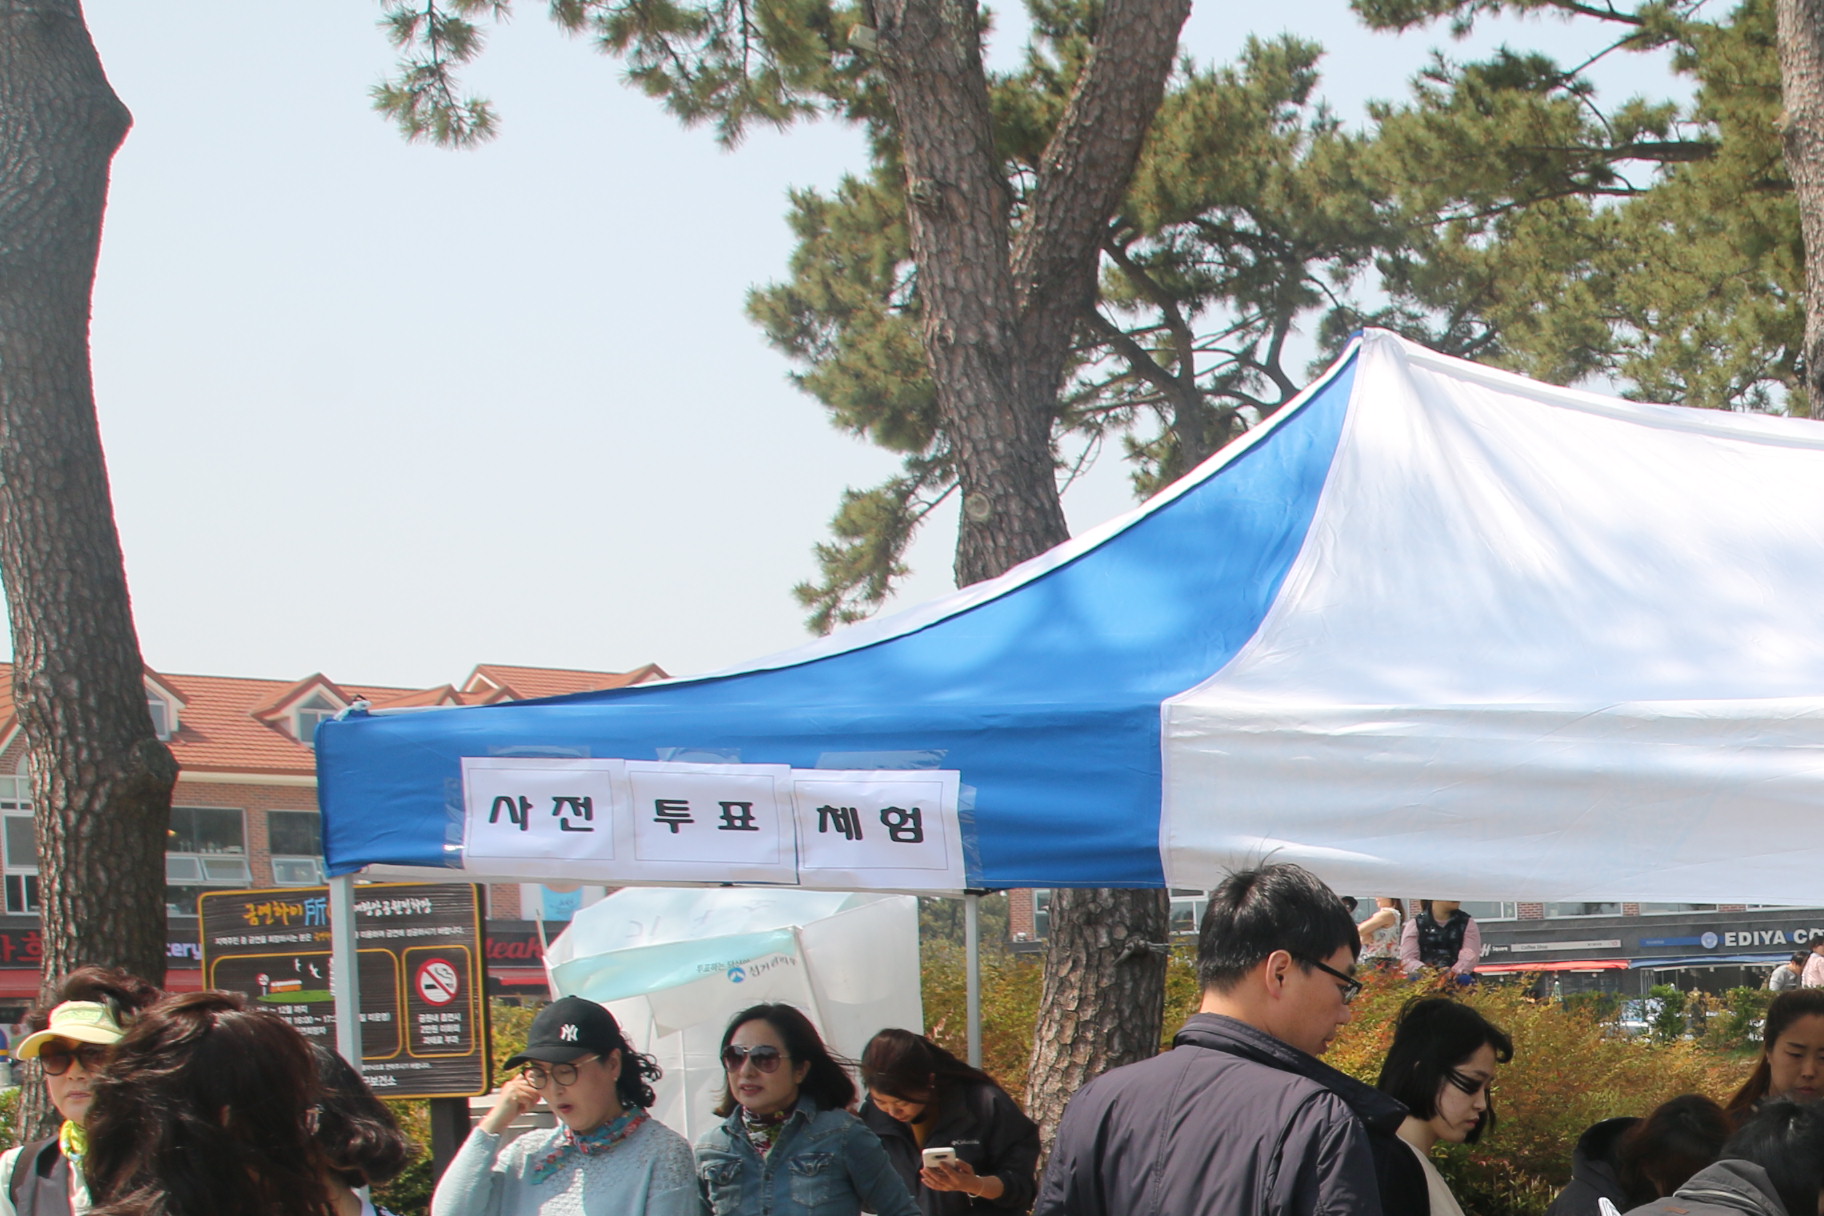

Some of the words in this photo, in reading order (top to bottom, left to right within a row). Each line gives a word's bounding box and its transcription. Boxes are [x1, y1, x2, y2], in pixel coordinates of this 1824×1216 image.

[489, 795, 594, 832] 사전
[653, 799, 759, 834] 투표
[816, 804, 924, 844] 체험
[1724, 930, 1787, 947] EDIYA
